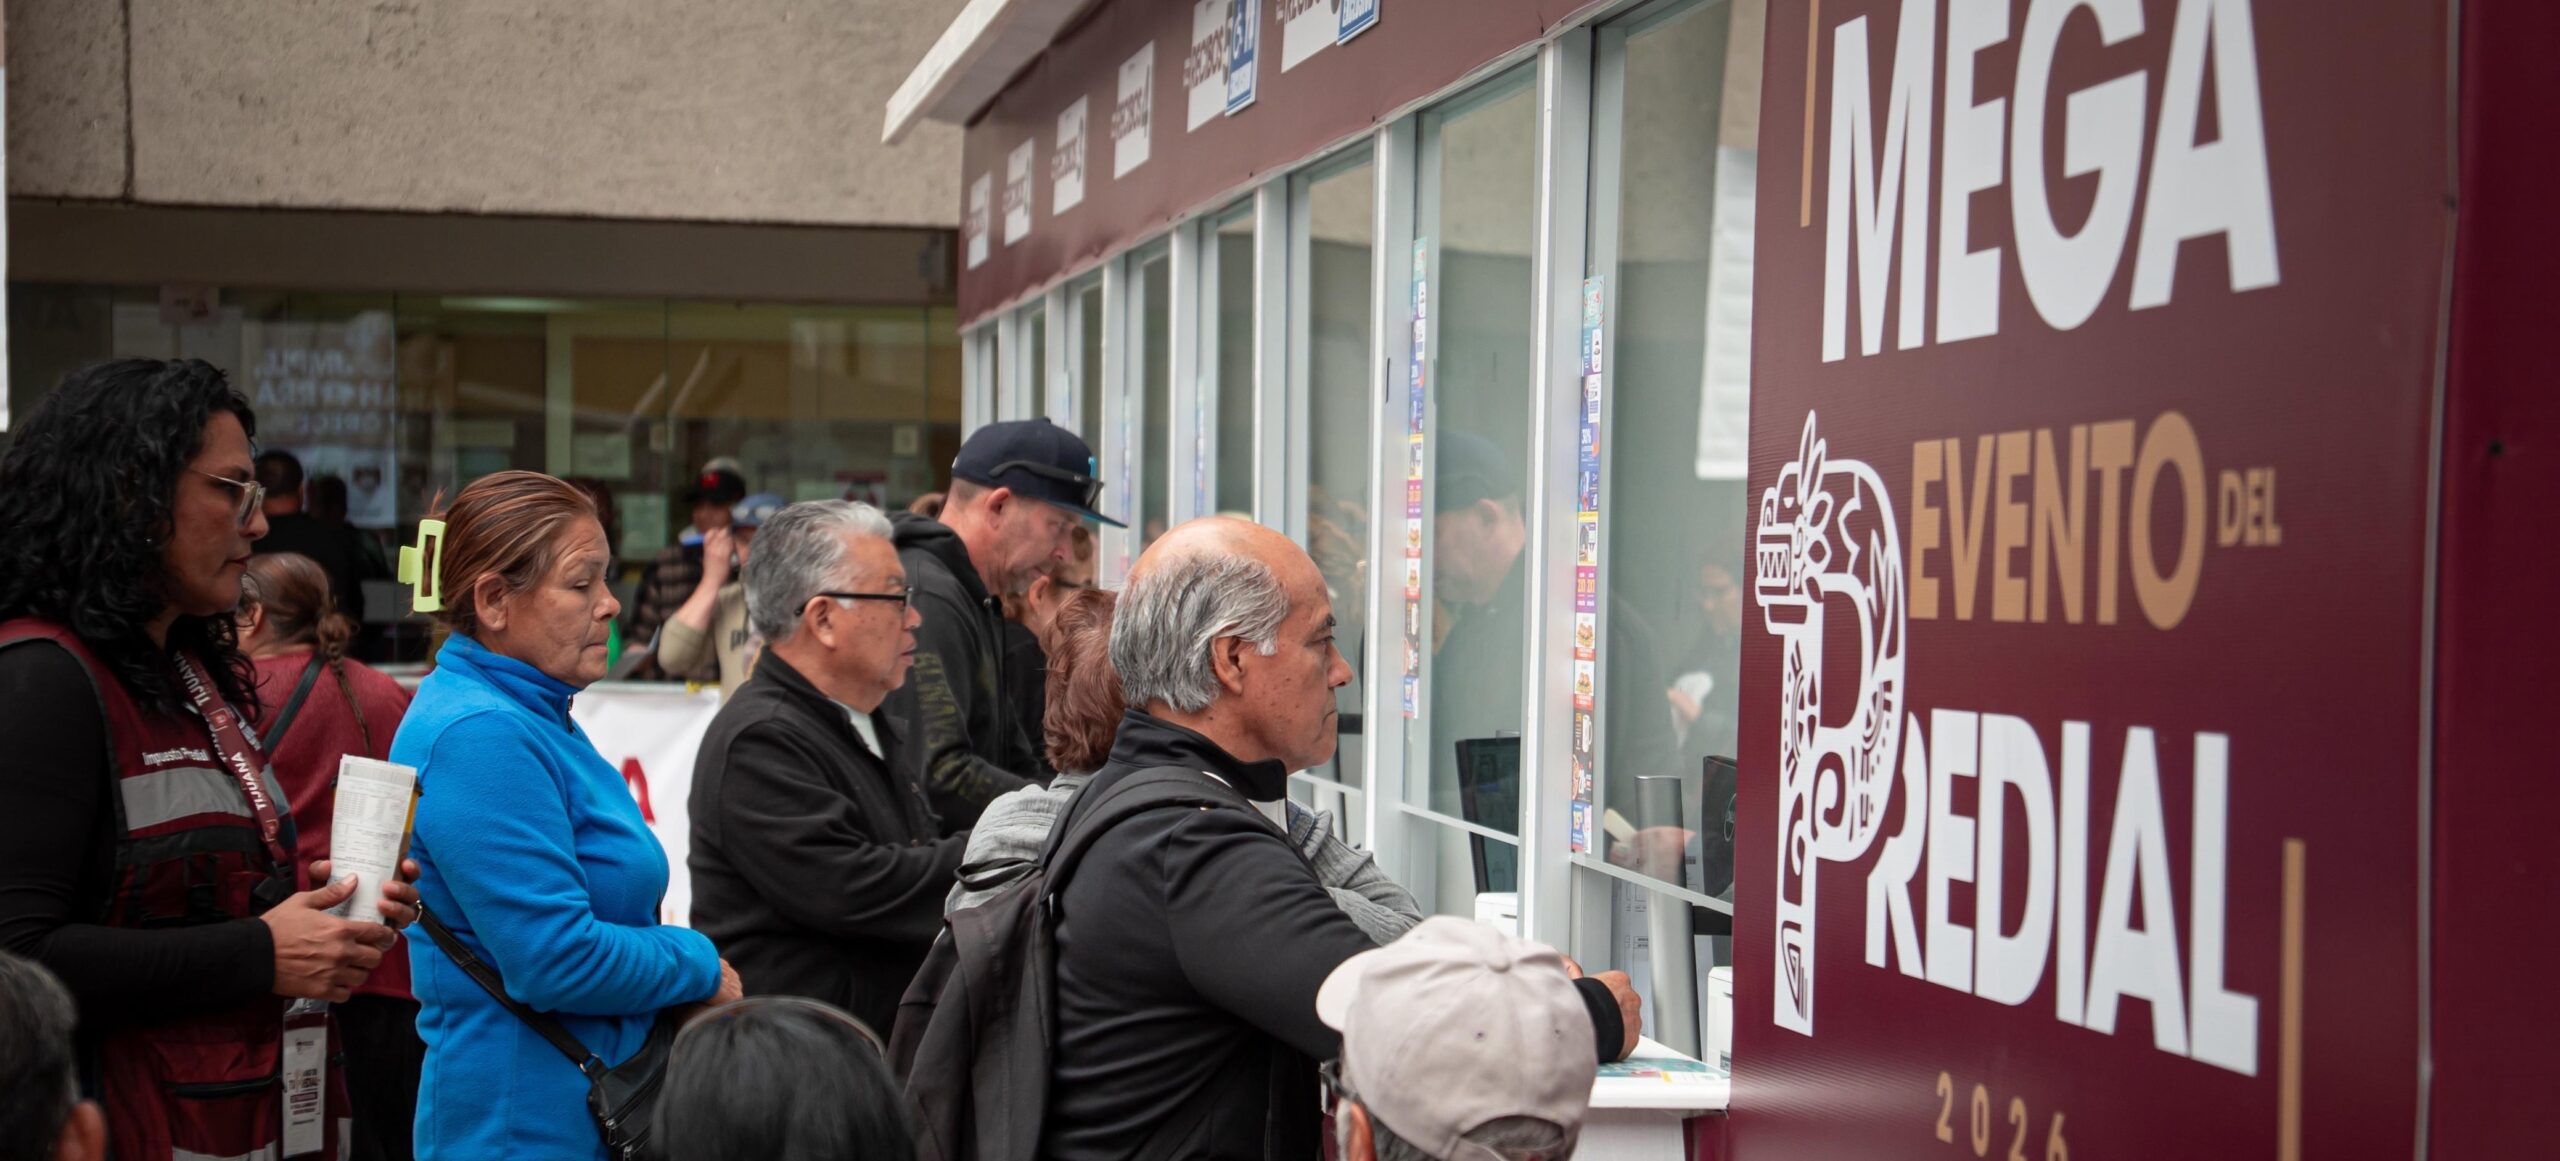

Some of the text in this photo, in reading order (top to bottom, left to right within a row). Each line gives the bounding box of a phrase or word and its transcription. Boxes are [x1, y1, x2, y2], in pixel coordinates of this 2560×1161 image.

[1822, 0, 2282, 364] MEGA
[1908, 411, 2282, 631] EVENTO DEL
[230, 751, 268, 811] TIJUANA
[1936, 1070, 2069, 1161] 2026
